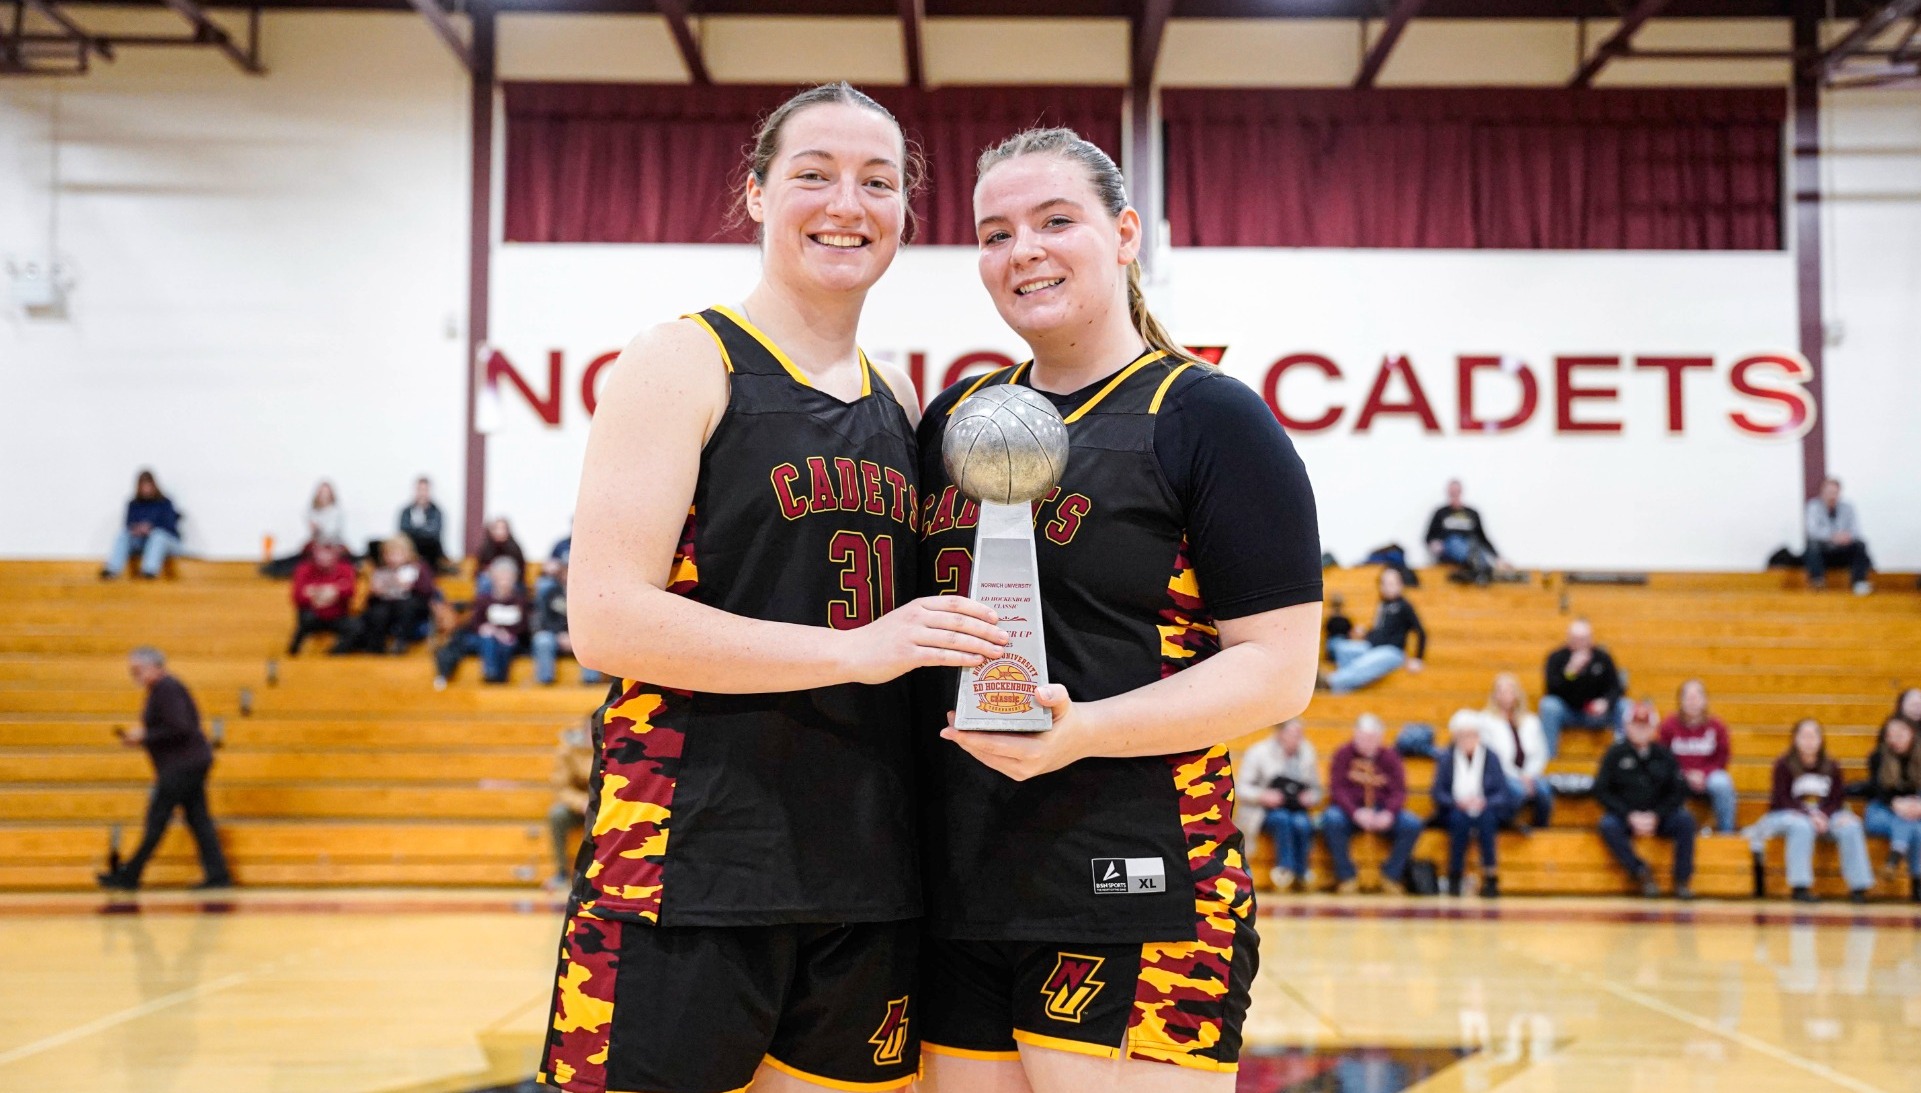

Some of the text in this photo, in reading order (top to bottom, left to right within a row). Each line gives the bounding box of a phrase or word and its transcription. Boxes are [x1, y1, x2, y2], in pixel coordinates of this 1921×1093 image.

[1261, 351, 1815, 435] CADETS
[827, 530, 896, 632] 31
[973, 682, 1037, 693] ED HOCKENBURY
[990, 695, 1020, 703] CLASSIC
[1139, 879, 1157, 889] XL
